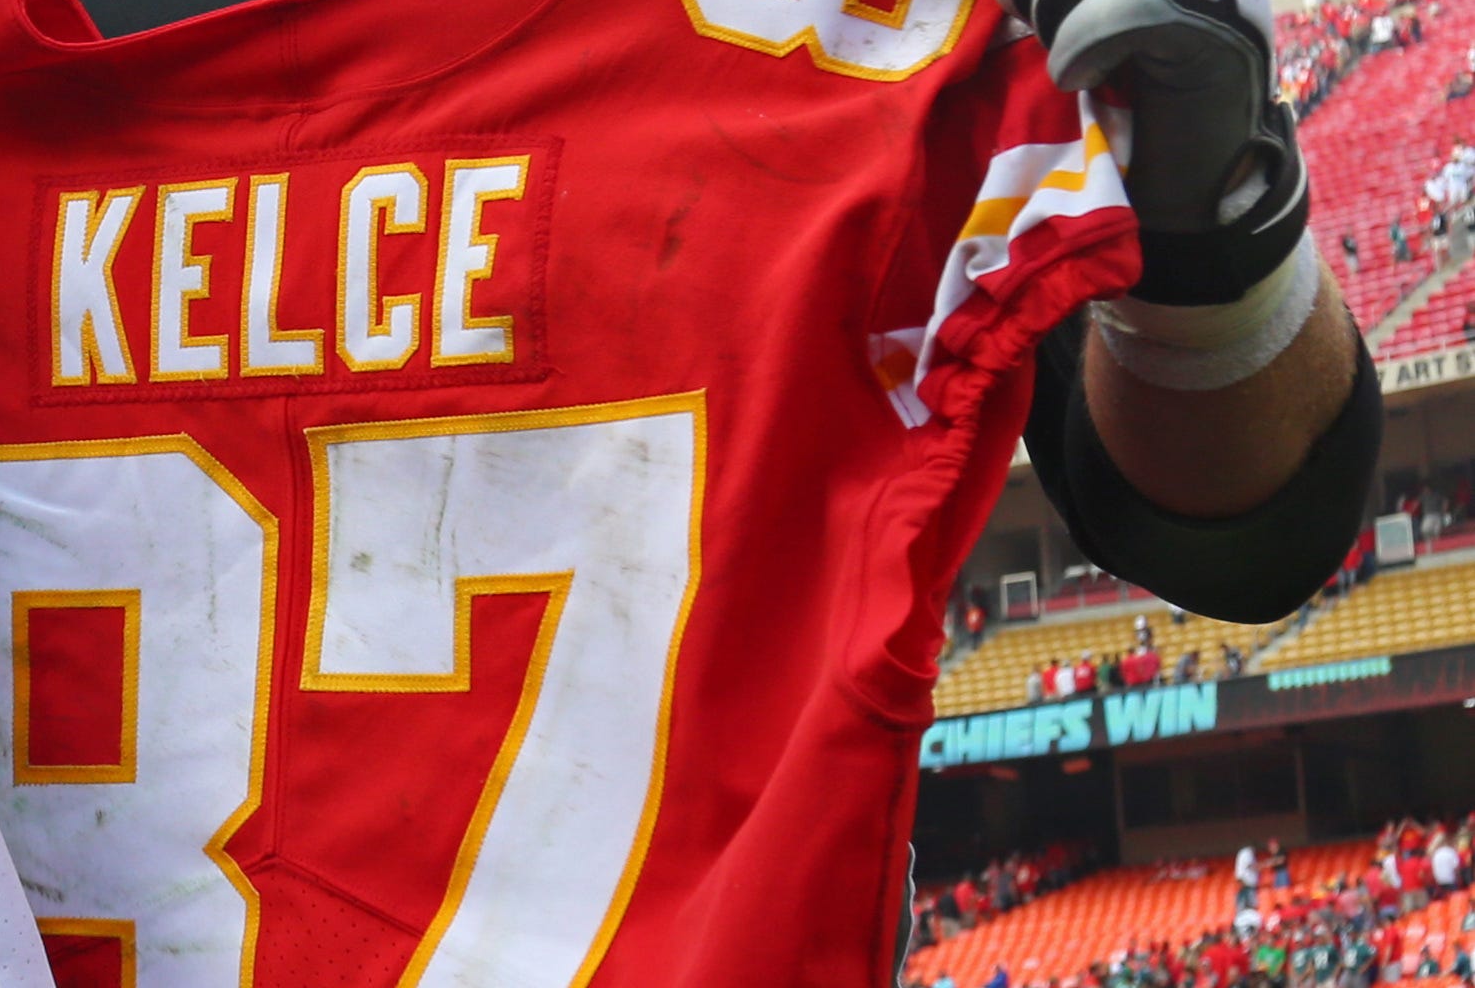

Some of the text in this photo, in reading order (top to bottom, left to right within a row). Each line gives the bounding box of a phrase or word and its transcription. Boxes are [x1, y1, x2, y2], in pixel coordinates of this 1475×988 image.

[51, 154, 531, 388] KELCE
[1398, 356, 1444, 384] ART
[919, 680, 1218, 769] CHIEFS WIN
